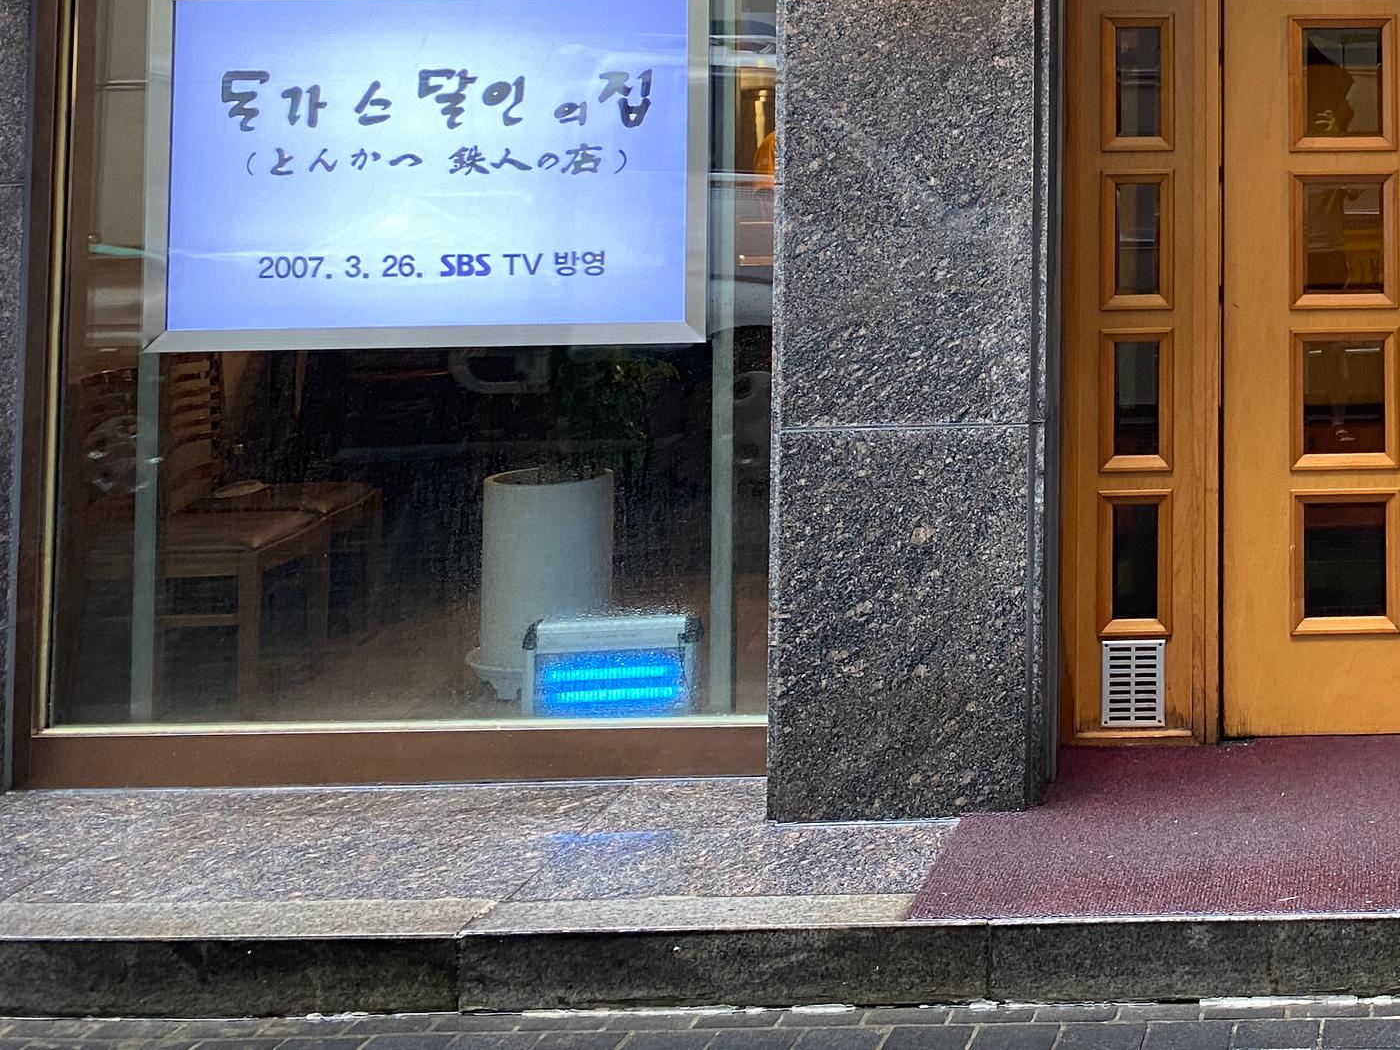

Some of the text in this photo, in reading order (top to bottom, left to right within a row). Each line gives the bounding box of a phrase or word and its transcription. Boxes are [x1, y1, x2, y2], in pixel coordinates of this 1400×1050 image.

[258, 251, 606, 280] 2007. 3. 26. SBS TV 방영
